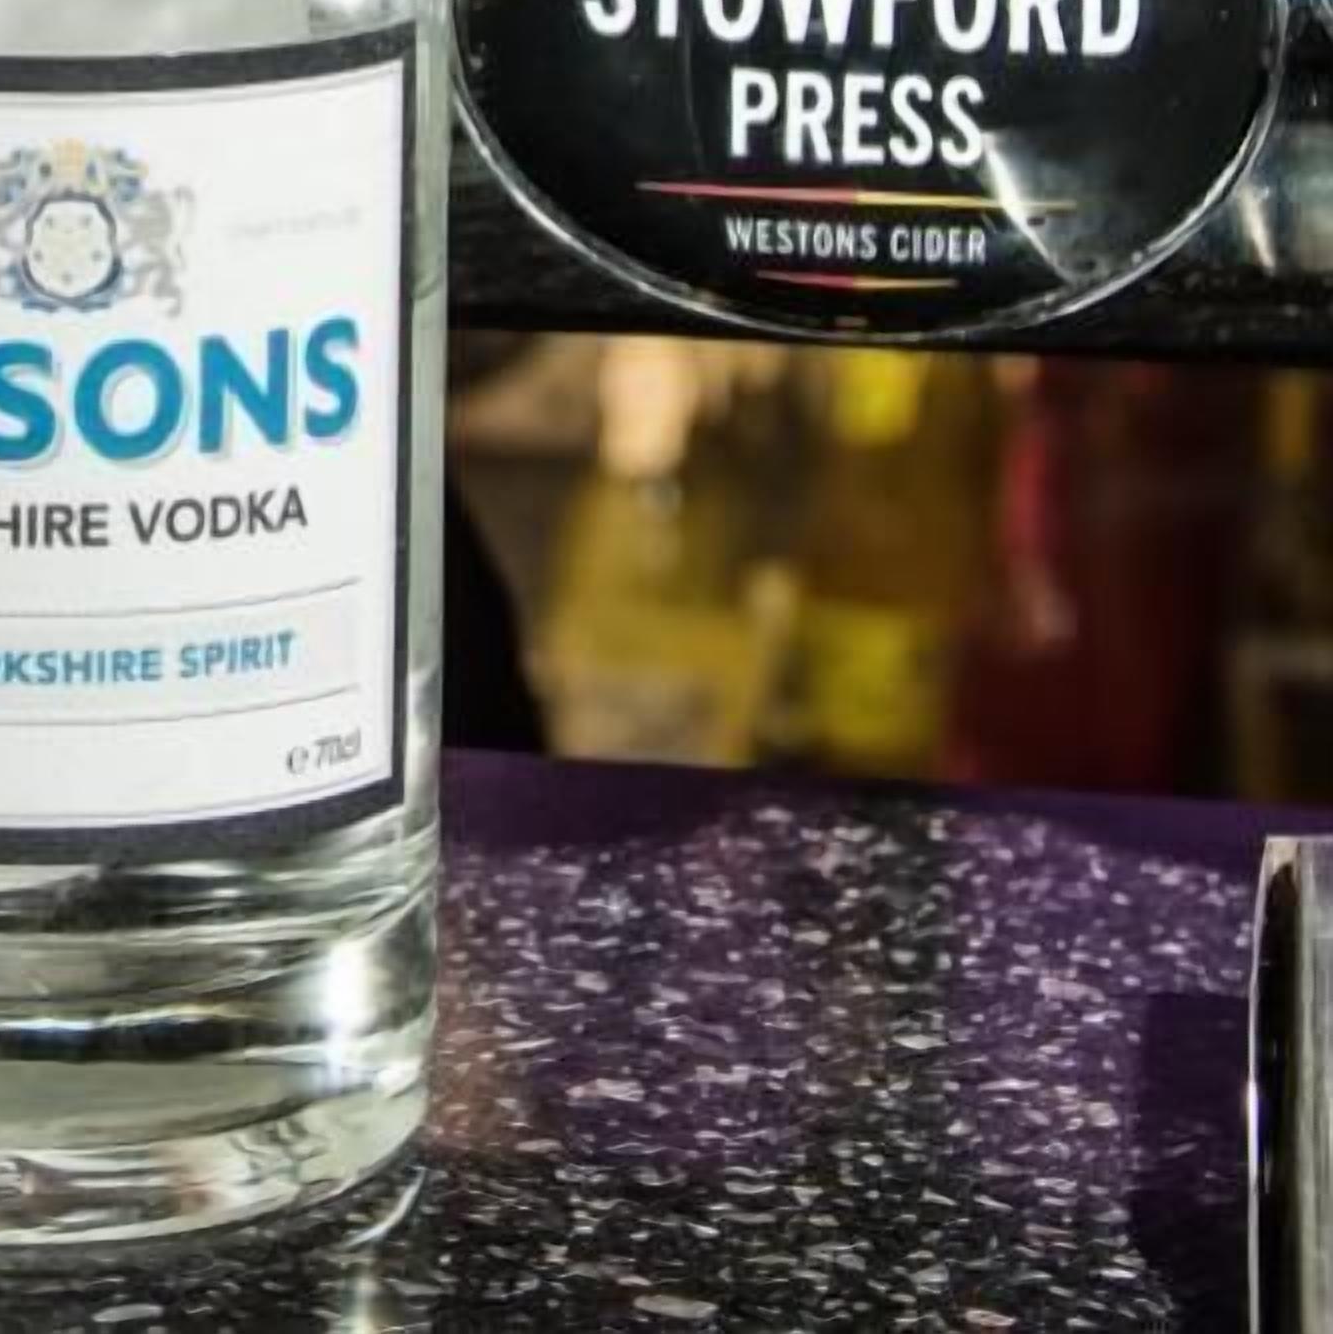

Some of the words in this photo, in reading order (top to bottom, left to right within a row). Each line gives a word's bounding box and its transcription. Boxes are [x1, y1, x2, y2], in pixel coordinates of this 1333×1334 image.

[730, 69, 986, 167] PRESS
[724, 216, 876, 259] WESTONS
[890, 223, 987, 264] CIDER
[130, 486, 308, 545] VODKA
[180, 630, 294, 679] SPIRIT
